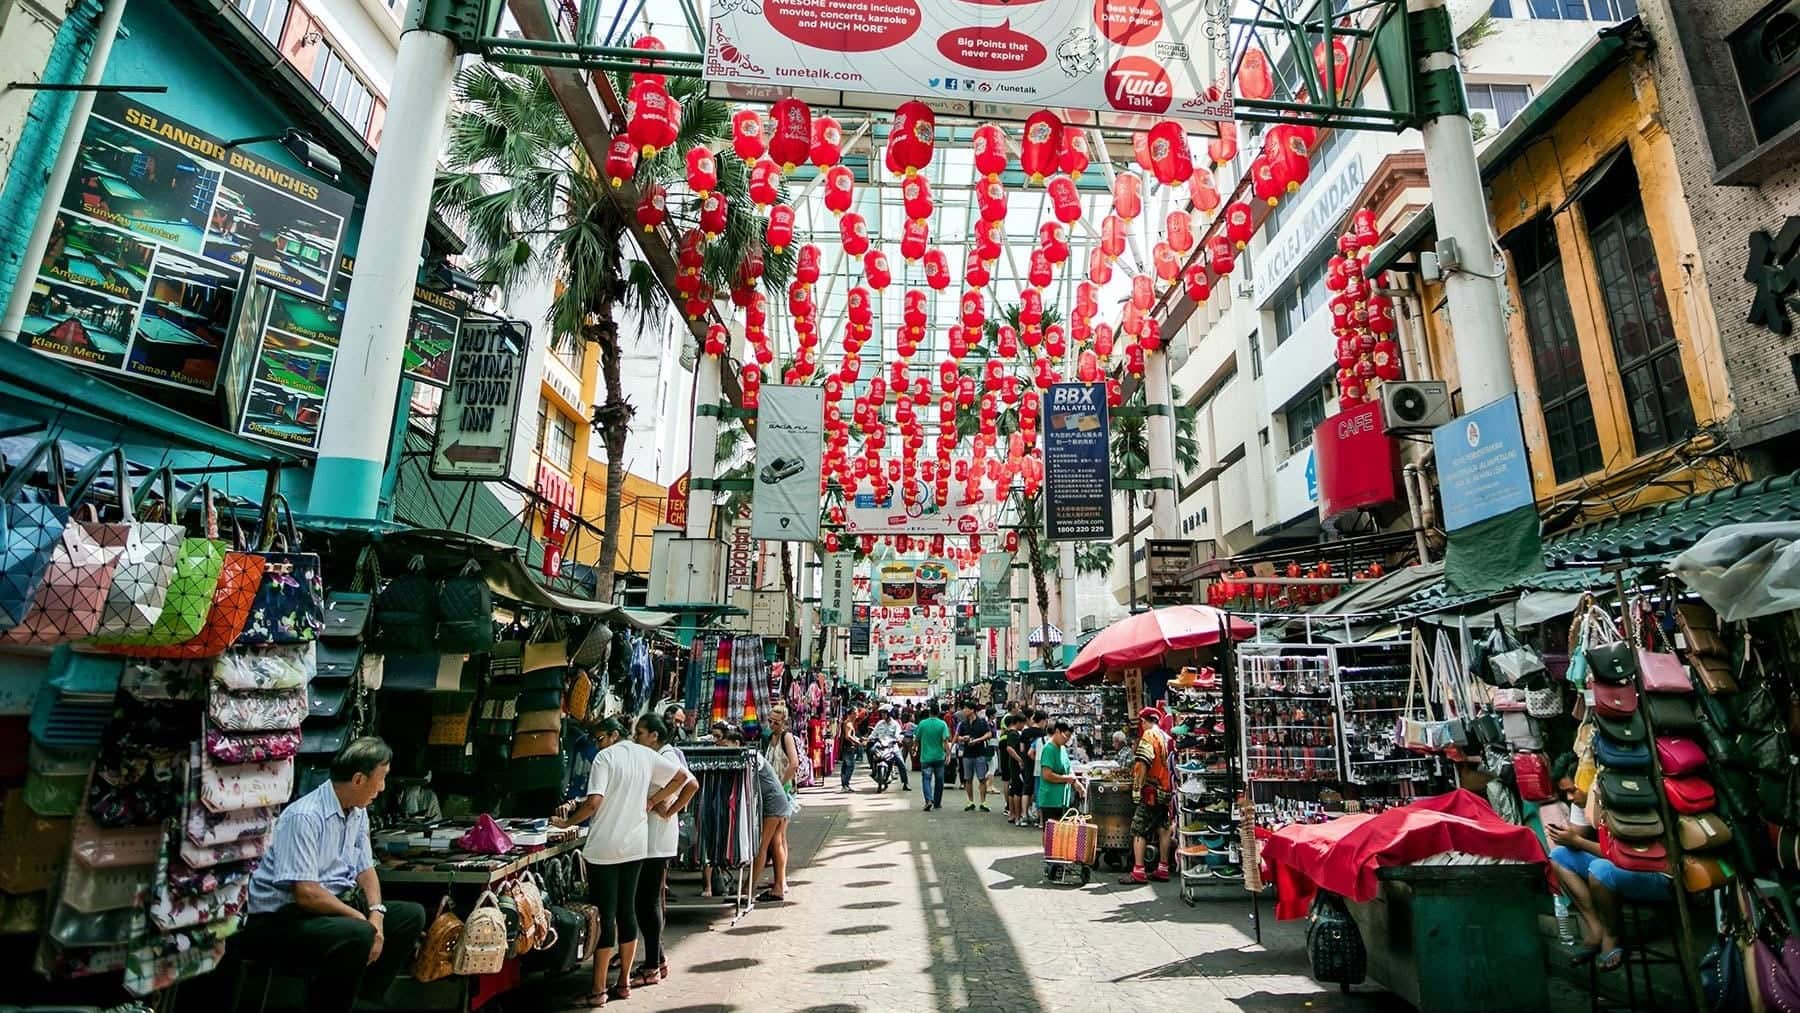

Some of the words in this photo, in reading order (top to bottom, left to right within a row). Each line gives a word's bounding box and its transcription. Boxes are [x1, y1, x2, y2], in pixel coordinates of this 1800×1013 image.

[779, 8, 818, 18] movies,
[820, 11, 866, 22] concerts,
[868, 14, 908, 25] karaoke
[828, 1, 868, 11] rewards
[870, 3, 916, 16] including
[1106, 4, 1127, 14] Best
[1128, 6, 1154, 16] Value
[798, 20, 817, 28] and
[820, 22, 850, 31] MUCH
[1102, 14, 1127, 23] DATA
[957, 38, 974, 48] Big
[976, 39, 1007, 49] Points
[1009, 42, 1029, 51] that
[961, 49, 989, 58] never
[991, 52, 1025, 61] expire!
[775, 67, 863, 82] tunetalk.com
[995, 82, 1037, 94] /tunetalk
[1111, 70, 1168, 101] Tune
[1126, 95, 1153, 107] Talk
[126, 108, 226, 160] SELANGOR
[229, 152, 319, 200] BRANCHES
[82, 203, 131, 229] Sunway
[102, 281, 129, 296] Mall
[461, 327, 509, 352] HOTE
[31, 335, 69, 354] Klang
[73, 345, 106, 362] Meru
[130, 359, 167, 377] Taman
[455, 354, 513, 380] CHINA
[455, 379, 511, 406] TOWN
[1054, 387, 1095, 405] BBX
[1053, 404, 1096, 412] MALAYSIA
[459, 406, 495, 433] INN
[1338, 412, 1374, 440] CAFE
[247, 421, 262, 432] Old
[290, 433, 312, 443] Road
[1057, 526, 1075, 534] 1800
